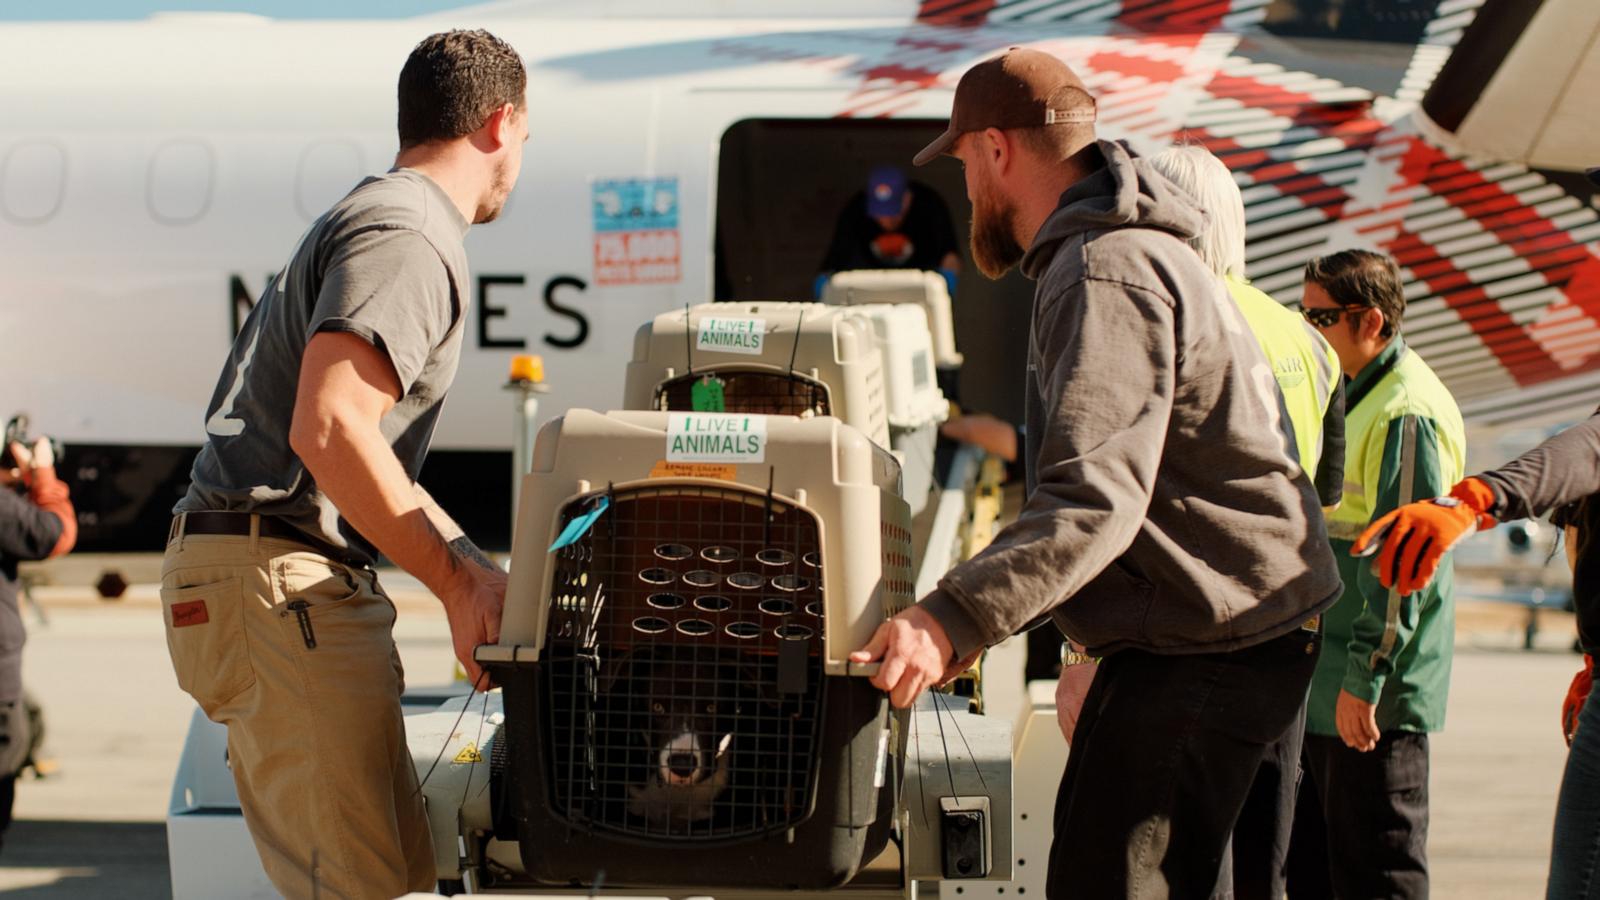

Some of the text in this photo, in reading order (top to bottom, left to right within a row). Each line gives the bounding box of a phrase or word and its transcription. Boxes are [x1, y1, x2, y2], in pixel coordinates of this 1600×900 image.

[717, 320, 746, 333] LIVE
[700, 331, 760, 349] ANIMALS
[696, 418, 738, 432] LIVE
[671, 434, 760, 454] ANIMALS
